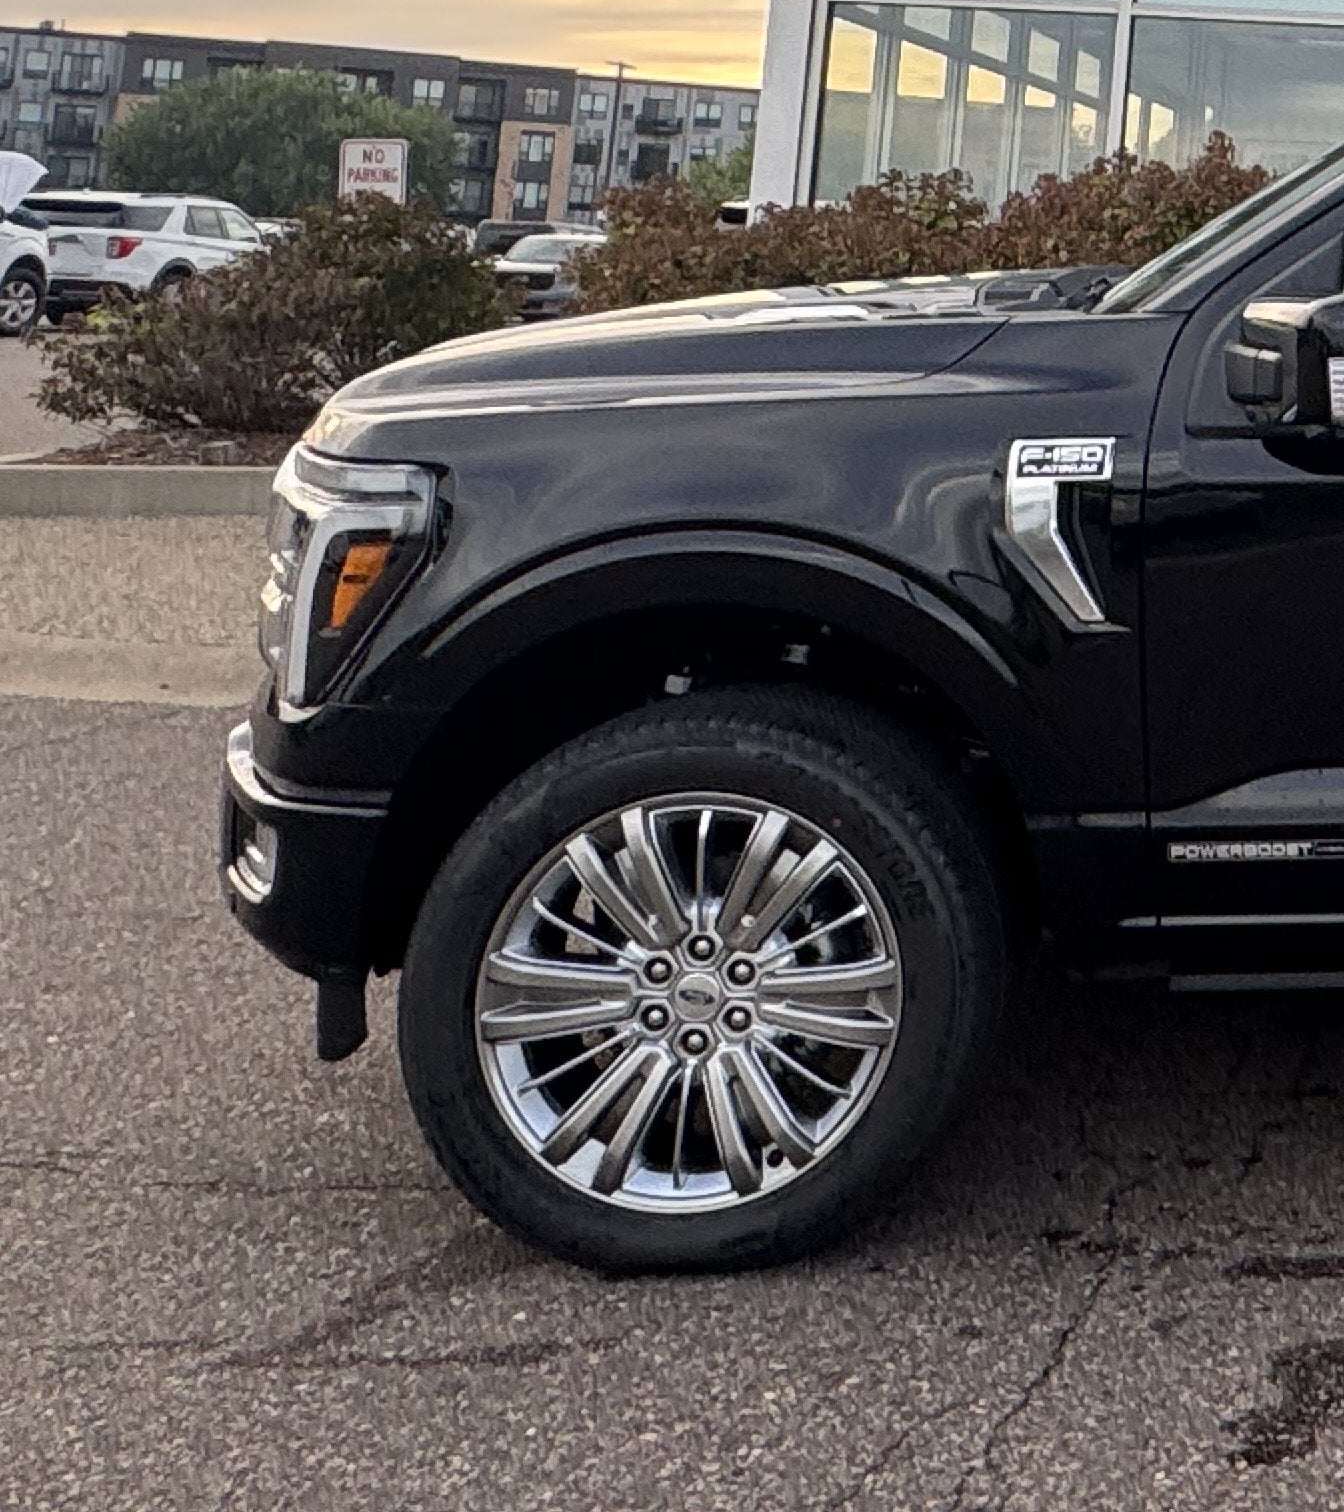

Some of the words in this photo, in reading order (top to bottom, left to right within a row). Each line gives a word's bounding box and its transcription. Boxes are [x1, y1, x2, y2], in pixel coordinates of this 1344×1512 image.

[362, 148, 385, 164] NO
[348, 168, 399, 183] PARKING
[1020, 446, 1104, 463] F-150
